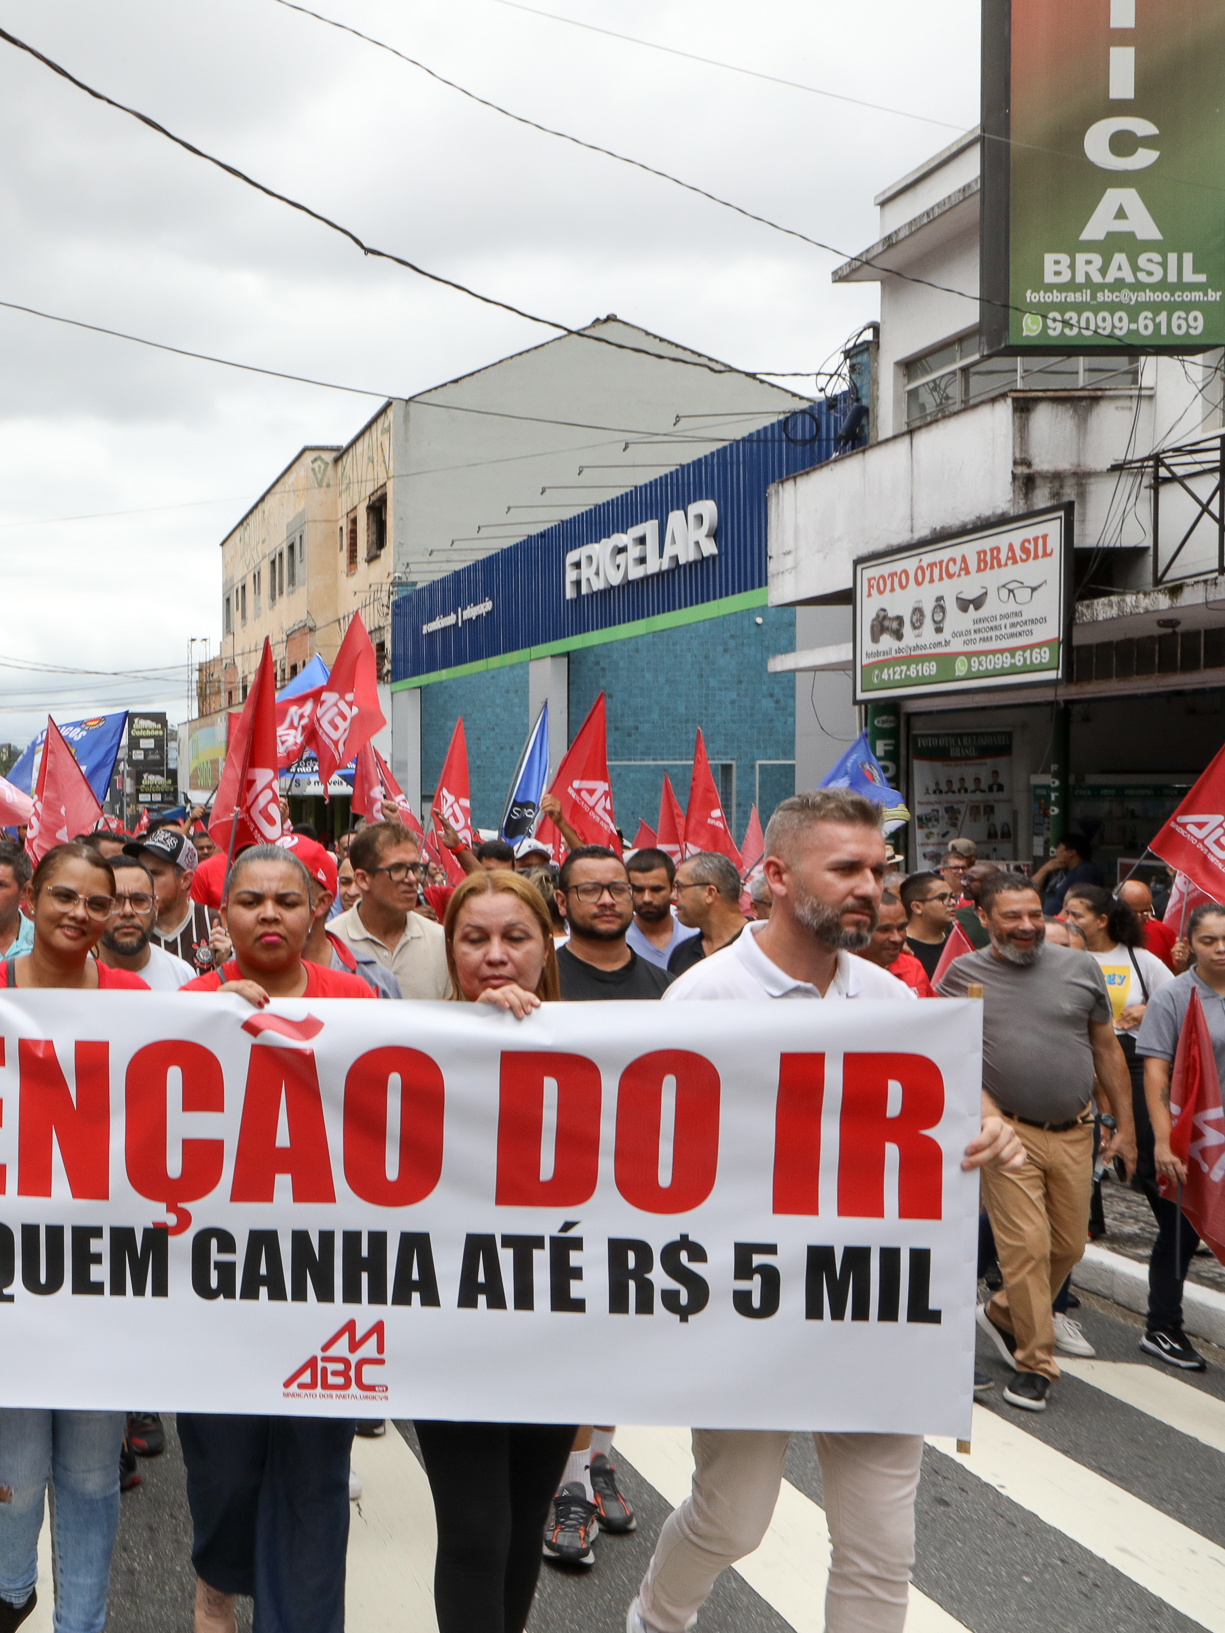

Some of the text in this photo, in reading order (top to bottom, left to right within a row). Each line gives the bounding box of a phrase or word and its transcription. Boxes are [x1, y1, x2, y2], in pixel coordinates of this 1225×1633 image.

[1043, 252, 1207, 283] BRASIL
[1025, 289, 1222, 304] fotobrasil_sbc@yahoo.com.br
[1046, 310, 1204, 336] 93099-6169
[565, 499, 718, 600] FRIGELAR
[866, 533, 1054, 598] FOTO ÓTICA BRASIL
[951, 628, 972, 639] ÓCULOS
[973, 624, 1003, 635] NACIONAIS
[1008, 616, 1048, 630] IMPORTADOS
[972, 614, 998, 626] SERVIÇOS
[962, 629, 1034, 647] FOTO PARA DOCUMENTOS
[881, 662, 937, 681] 4127-6169
[970, 647, 1050, 673] 93099-6169
[1169, 821, 1198, 845] SINDICATO
[495, 1048, 720, 1215] DO
[772, 1052, 945, 1220] IR
[191, 1227, 441, 1308] GANHA
[457, 1221, 587, 1313] ATÉ
[607, 1233, 710, 1323] R$
[732, 1241, 781, 1319] 5
[805, 1244, 942, 1325] MIL
[282, 1355, 388, 1392] ABC
[282, 1391, 317, 1399] SINDICATO
